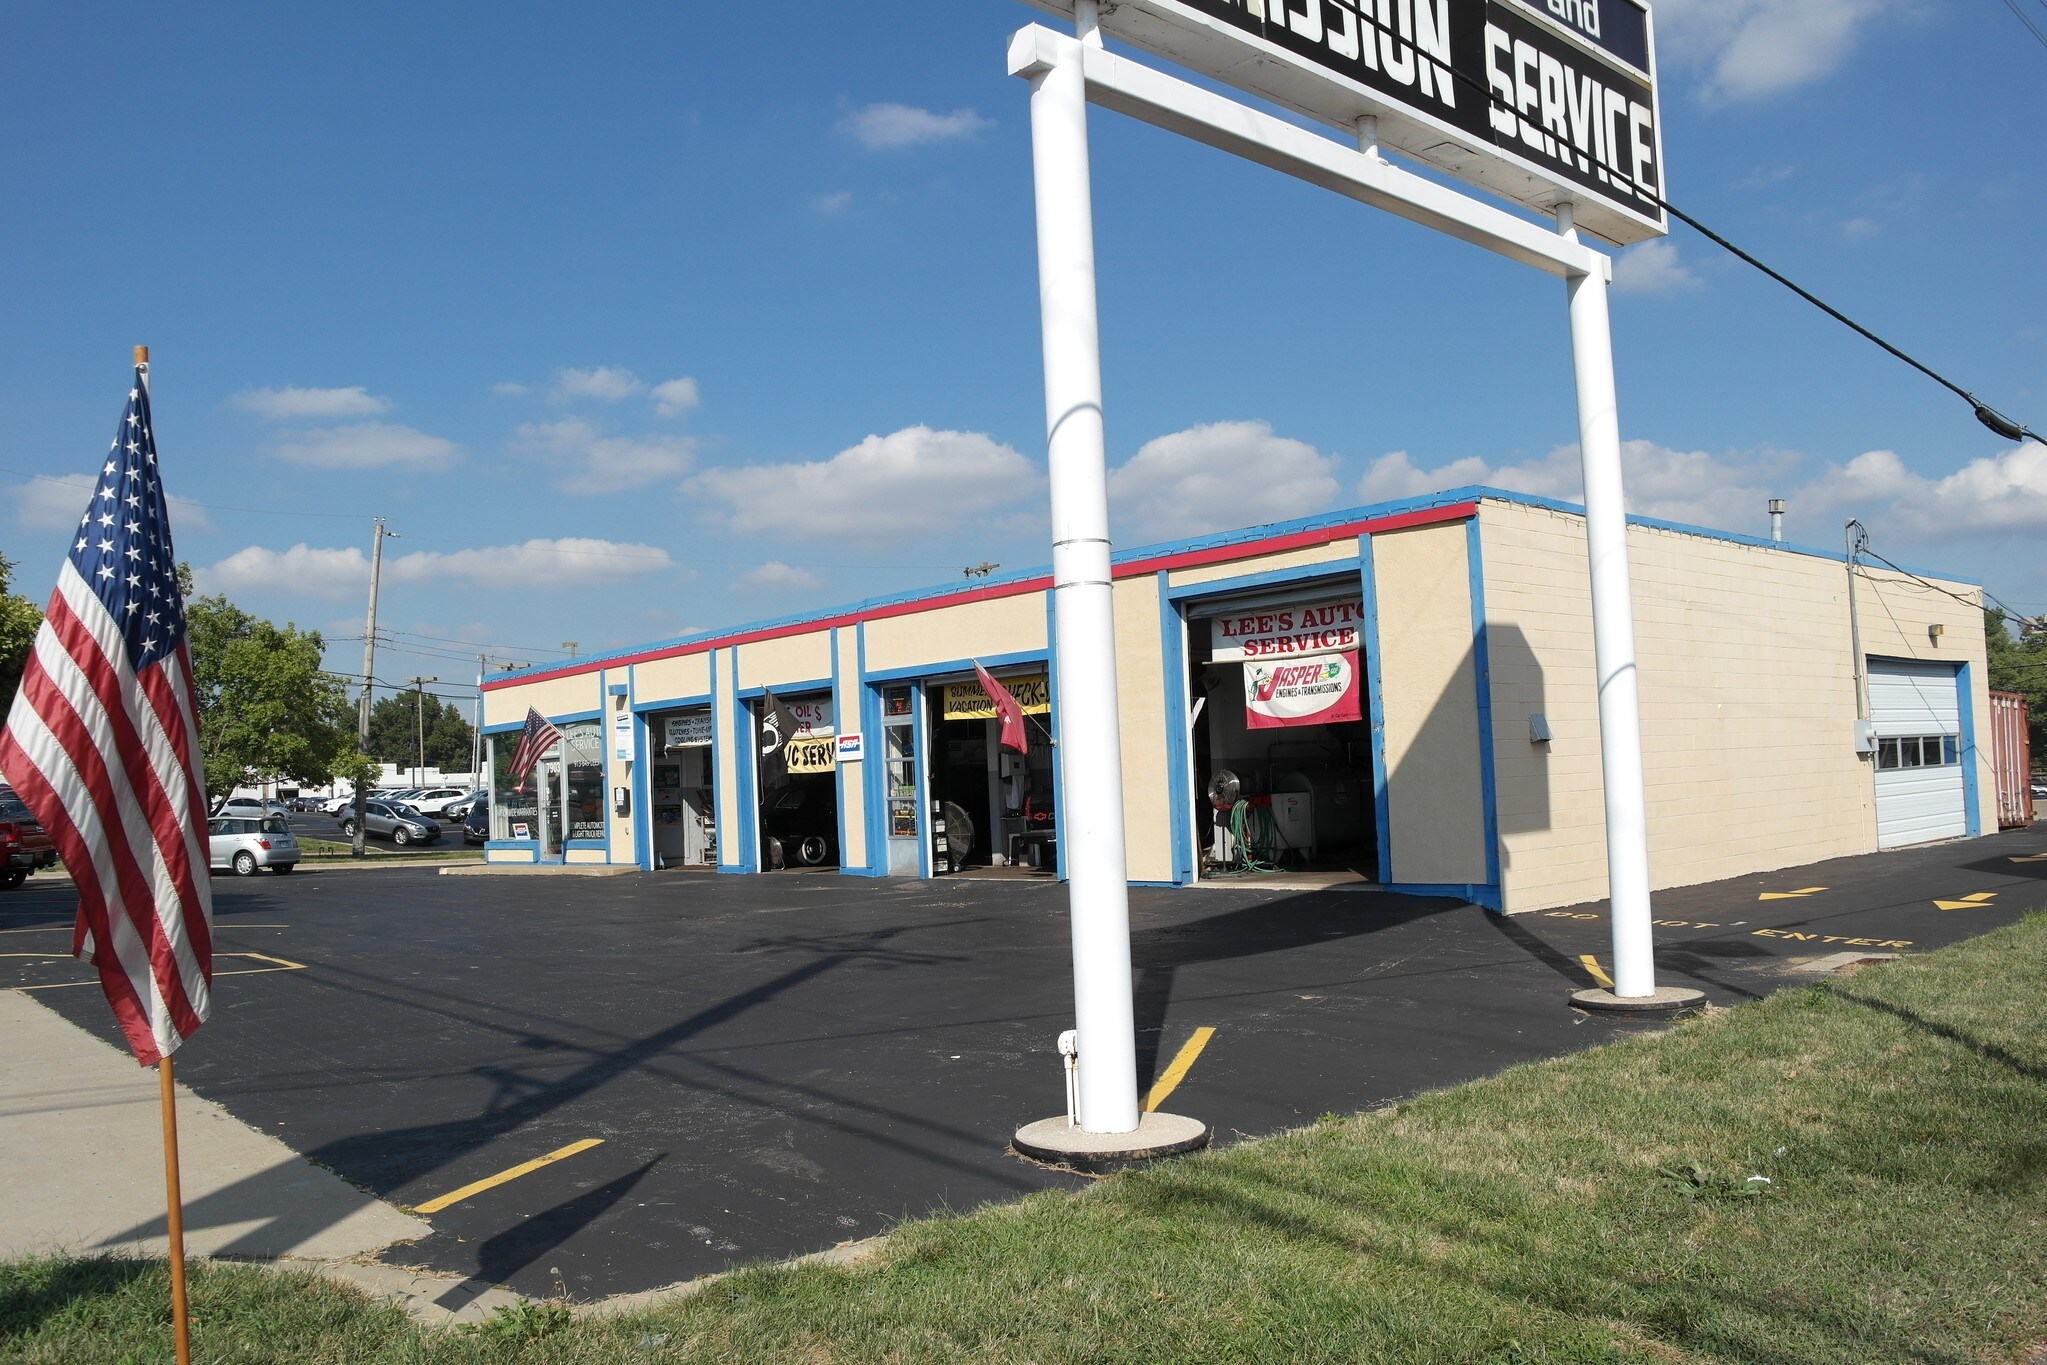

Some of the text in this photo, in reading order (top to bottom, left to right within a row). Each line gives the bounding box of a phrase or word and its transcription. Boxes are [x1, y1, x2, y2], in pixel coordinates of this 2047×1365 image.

[1222, 0, 1658, 207] SION SERVICE
[1222, 612, 1294, 637] LEE'S
[1243, 627, 1356, 656] SERVICE
[1256, 663, 1323, 701] JASPER
[1276, 687, 1298, 698] ENGINES
[1301, 682, 1342, 696] TRANSMISSIONS
[951, 685, 988, 698] SUMME
[1003, 681, 1051, 706] HECK-
[796, 705, 811, 718] OIL
[950, 699, 993, 713] VACATION
[571, 737, 600, 751] SERVICE
[802, 741, 835, 767] SERV
[546, 762, 561, 774] 7903
[1544, 911, 1599, 920] DO
[1751, 928, 1914, 948] ENTER
